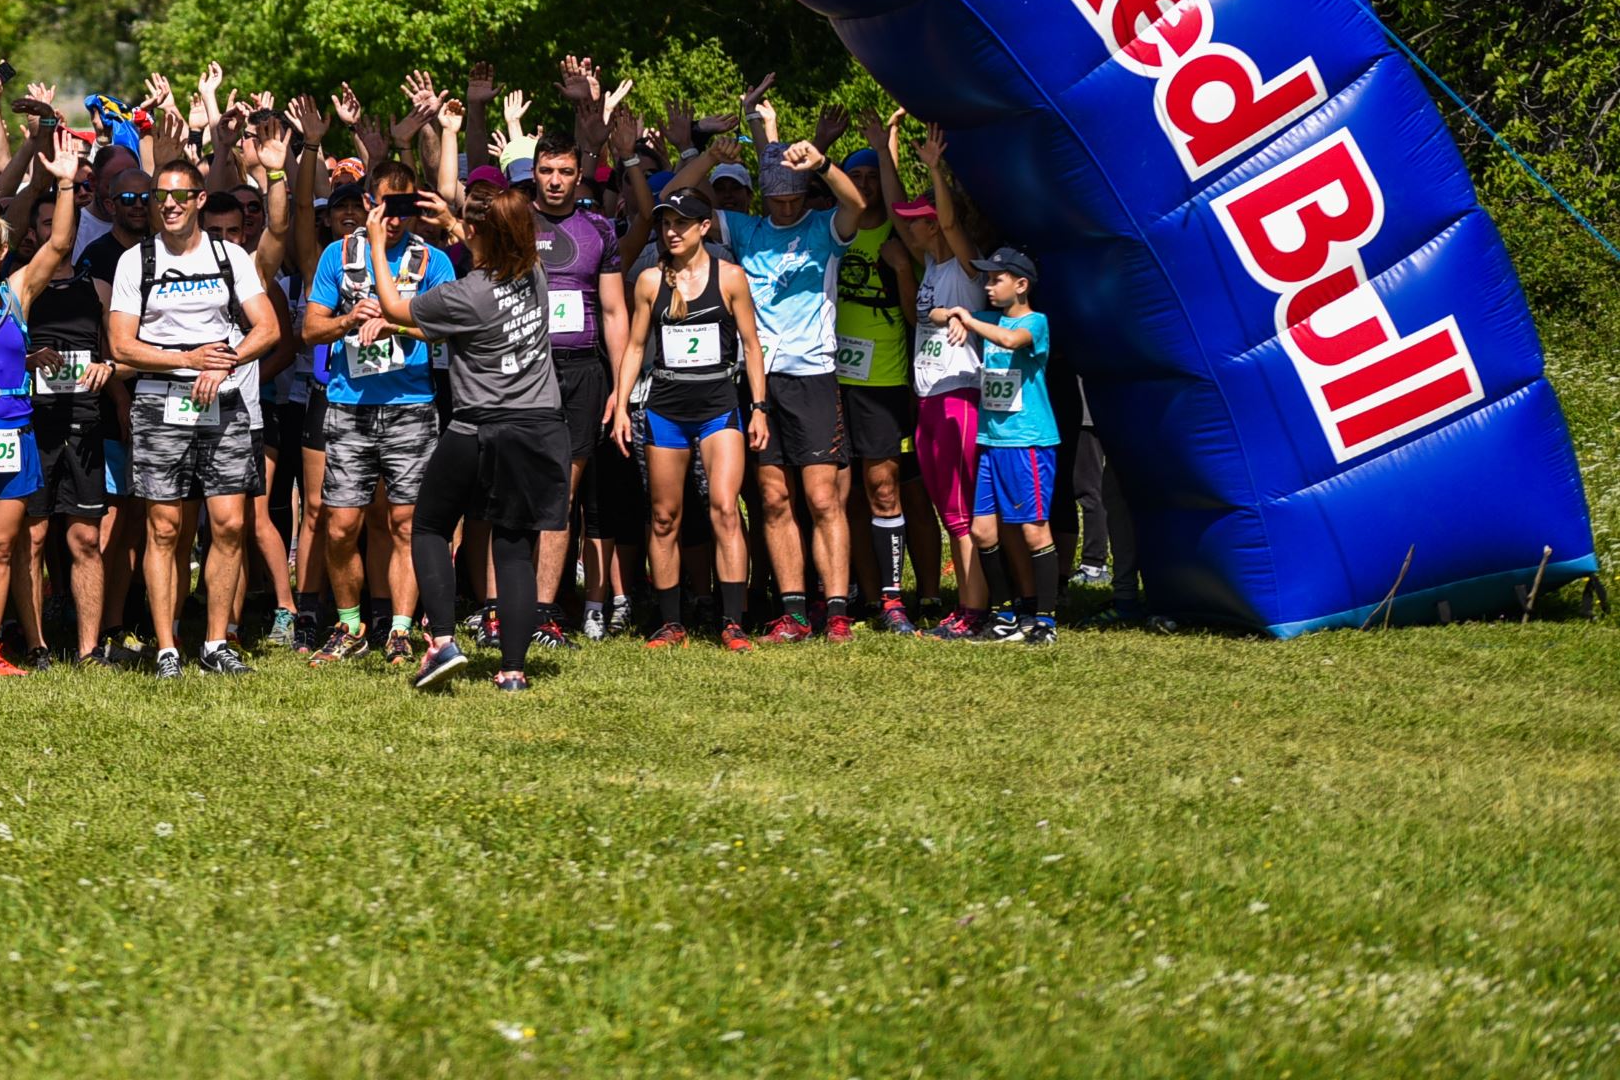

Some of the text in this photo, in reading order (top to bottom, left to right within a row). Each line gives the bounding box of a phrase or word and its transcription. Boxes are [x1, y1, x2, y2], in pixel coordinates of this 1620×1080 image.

[156, 279, 221, 295] ZADAR
[1223, 137, 1475, 451] Bull
[498, 286, 532, 310] FORCE
[511, 301, 526, 316] OF
[502, 306, 542, 332] NATURE
[687, 337, 699, 354] 2
[833, 347, 865, 367] 02
[983, 381, 1015, 399] 303
